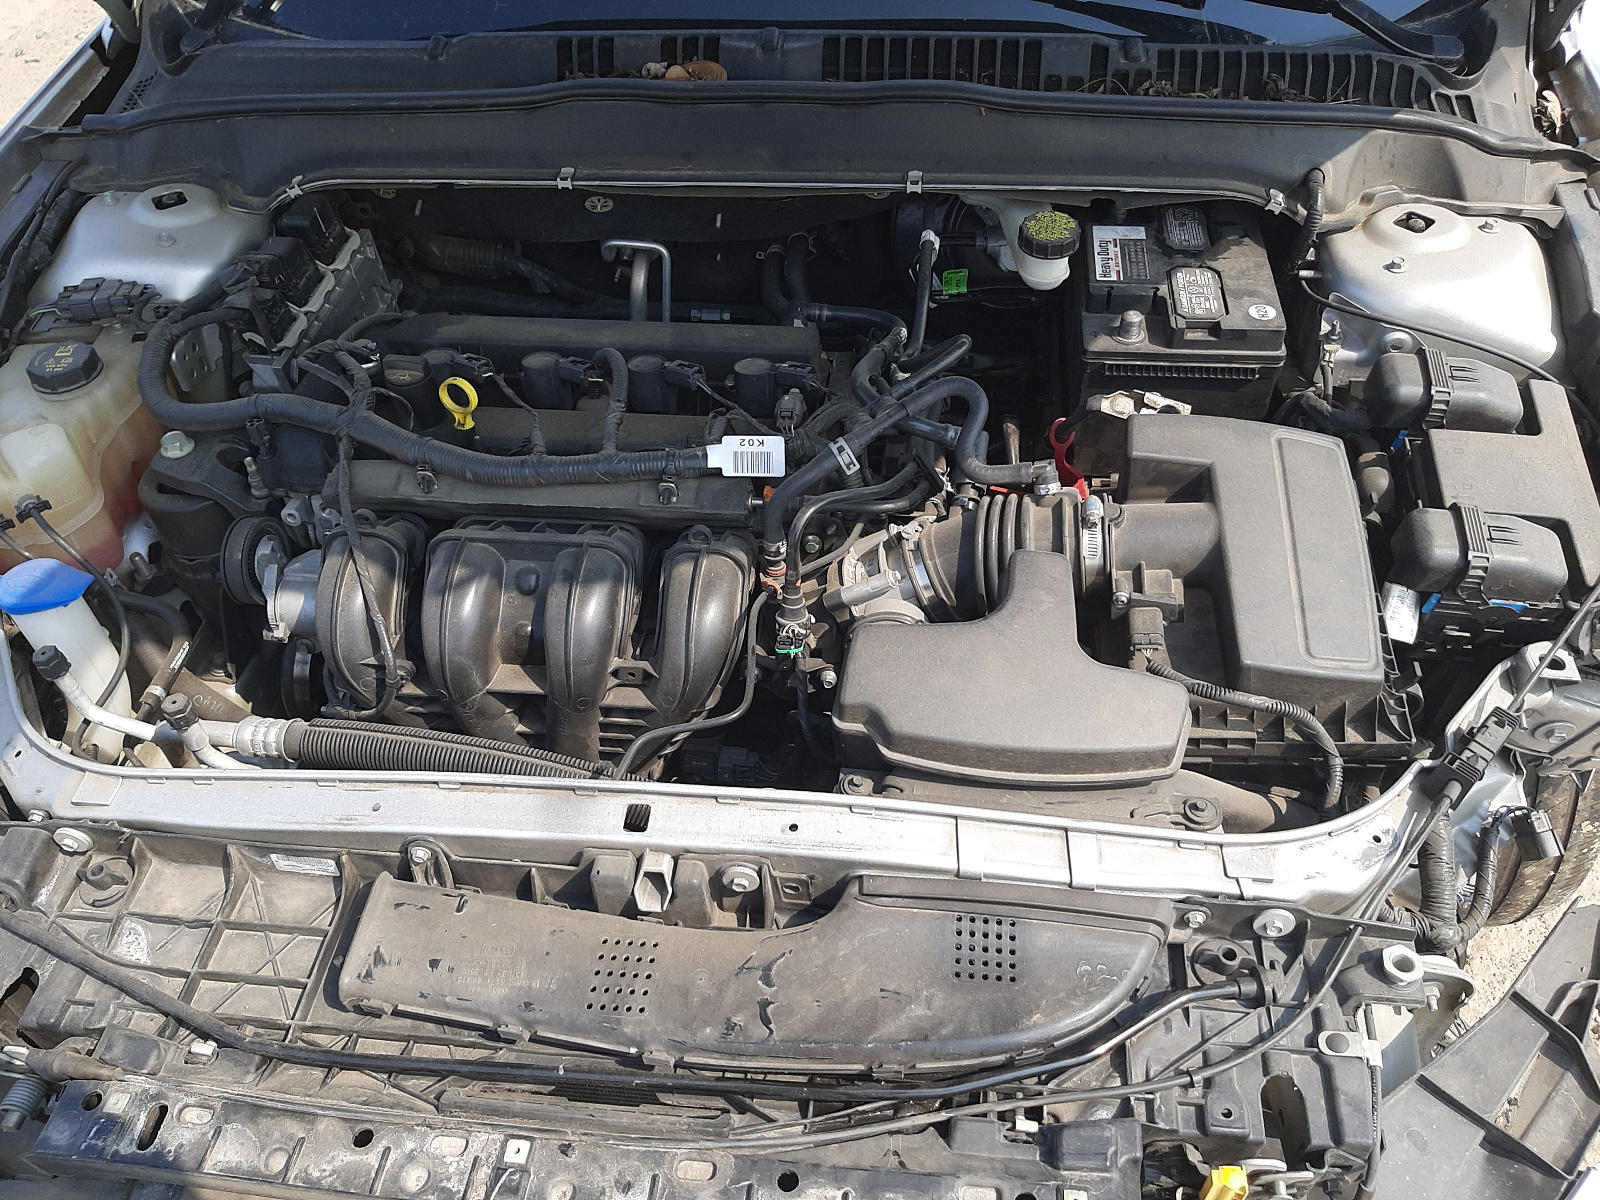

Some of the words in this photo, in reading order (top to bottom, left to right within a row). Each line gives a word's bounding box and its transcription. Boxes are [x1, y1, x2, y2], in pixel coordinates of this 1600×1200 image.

[1097, 240, 1111, 256] Duty
[1099, 257, 1113, 278] Heavy
[739, 438, 765, 447] K02
